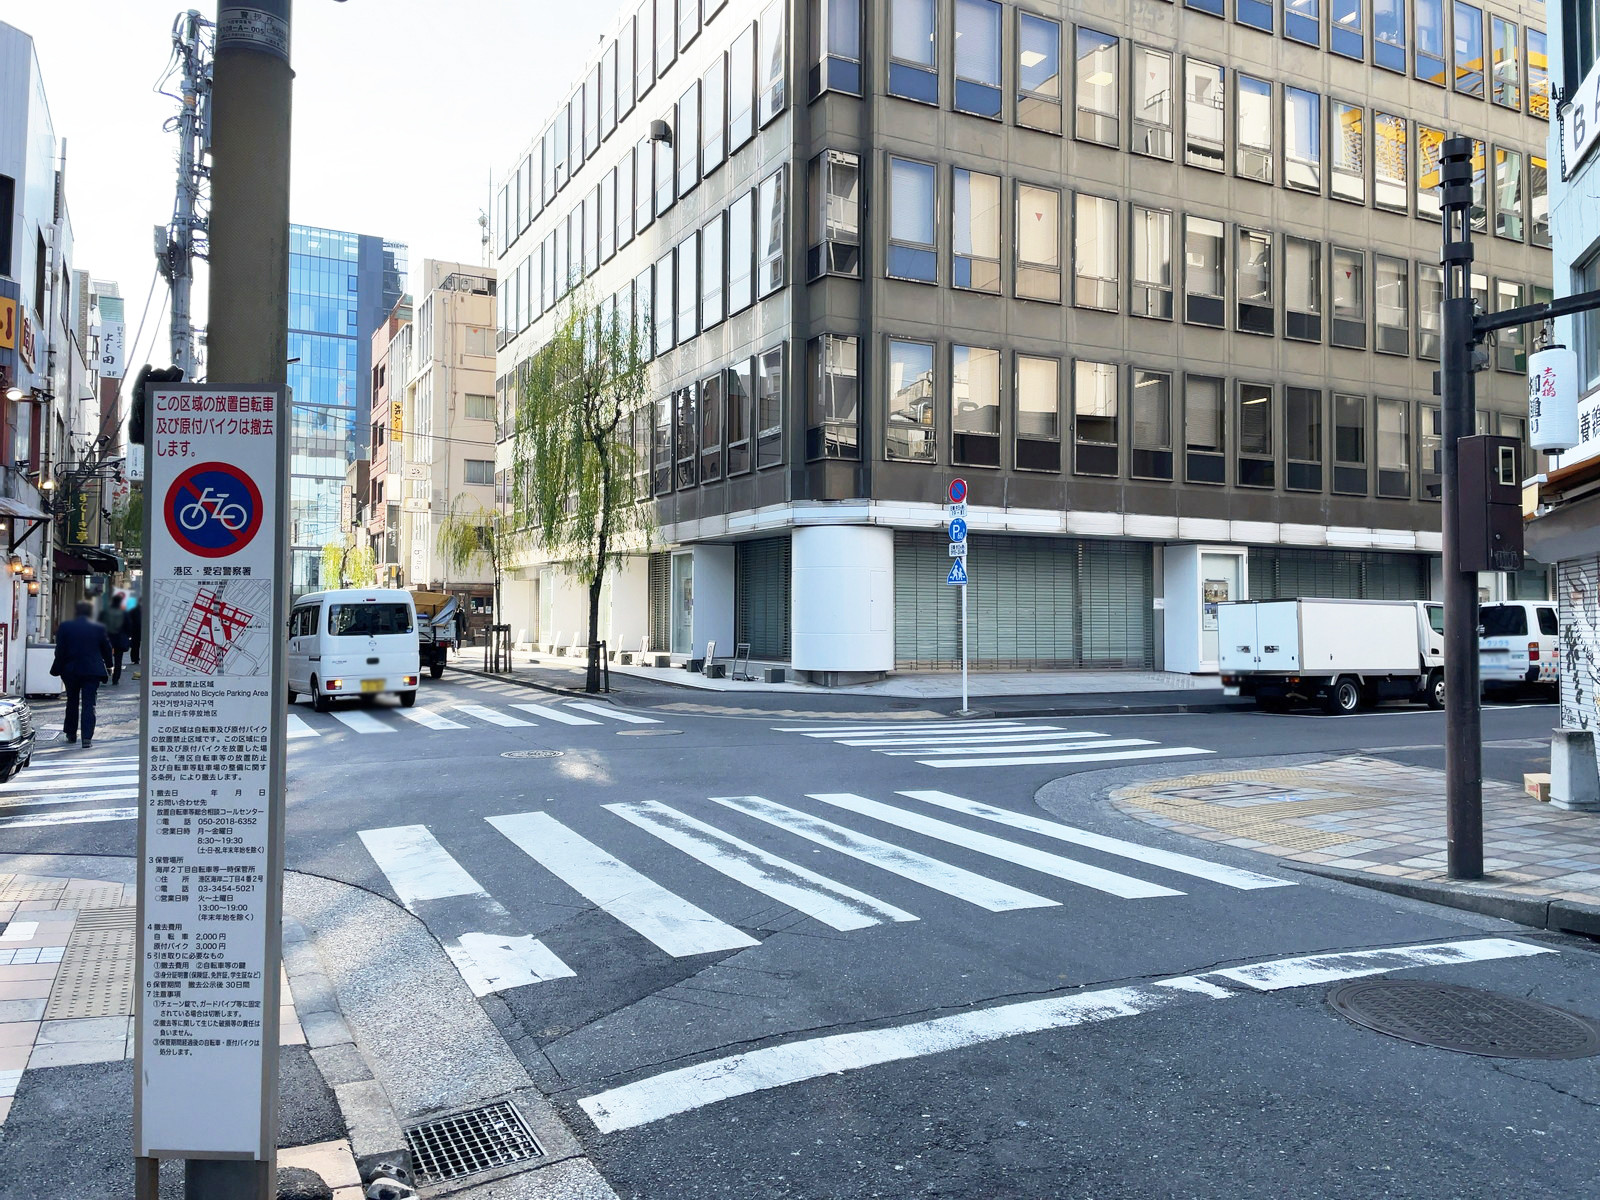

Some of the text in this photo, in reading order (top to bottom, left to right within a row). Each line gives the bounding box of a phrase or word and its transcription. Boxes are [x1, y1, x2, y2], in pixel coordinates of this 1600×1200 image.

[157, 395, 274, 412] この区域の放置自転車
[156, 418, 273, 435] 及び原付バイクは撤去
[157, 440, 195, 457] します。
[173, 566, 252, 576] 港区・愛宕警察署
[210, 789, 218, 797] 年
[234, 789, 242, 797] 月
[258, 789, 266, 797] 日
[198, 818, 257, 826] 050-2018-6352
[153, 952, 224, 960] 引き取りに必要なもの
[153, 981, 181, 989] 保管期間
[160, 1010, 242, 1018] されている場合は切断します。
[160, 1029, 193, 1037] 負いません。
